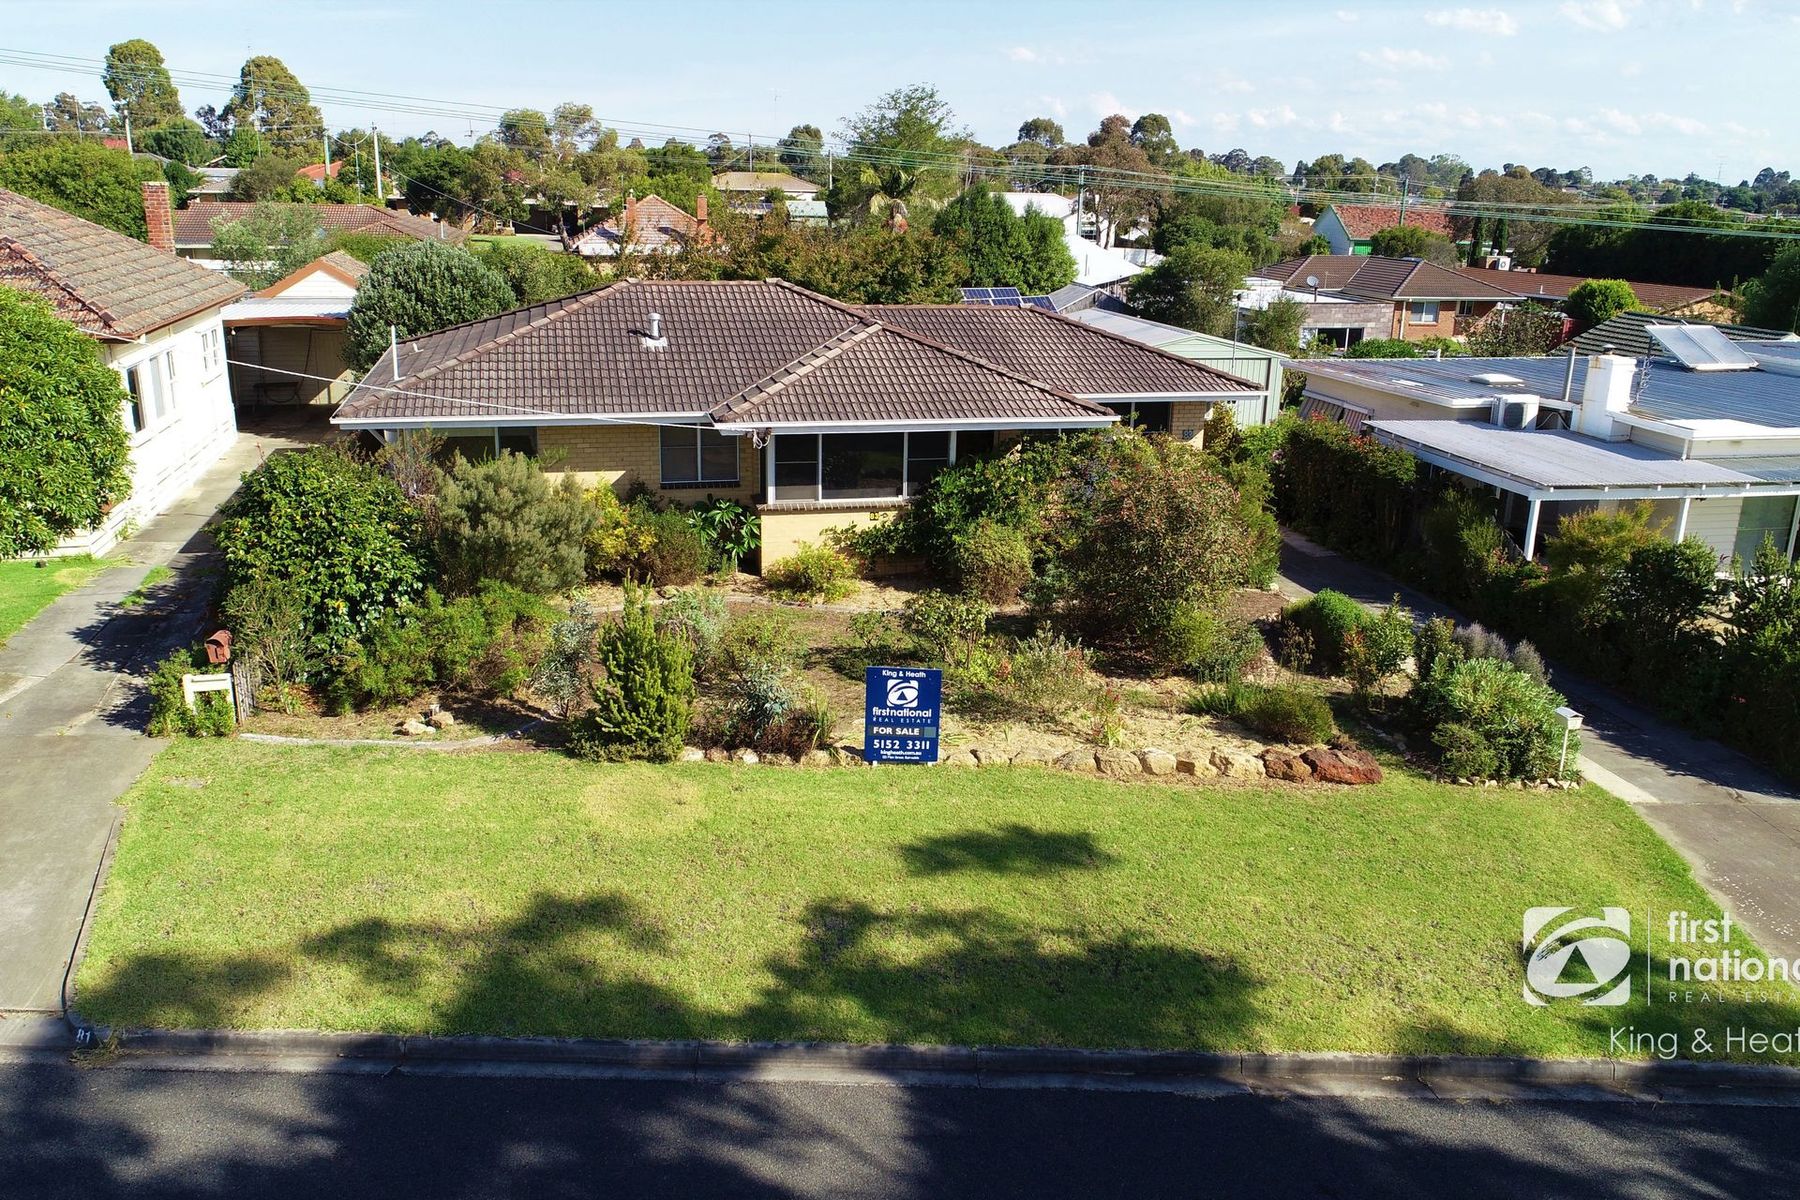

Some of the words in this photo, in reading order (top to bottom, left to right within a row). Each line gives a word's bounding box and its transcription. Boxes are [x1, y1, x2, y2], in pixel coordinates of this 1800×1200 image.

[882, 670, 897, 678] King
[873, 727, 893, 735] FOR
[895, 728, 920, 736] SALE
[873, 739, 900, 749] 5152
[906, 740, 930, 750] 3311
